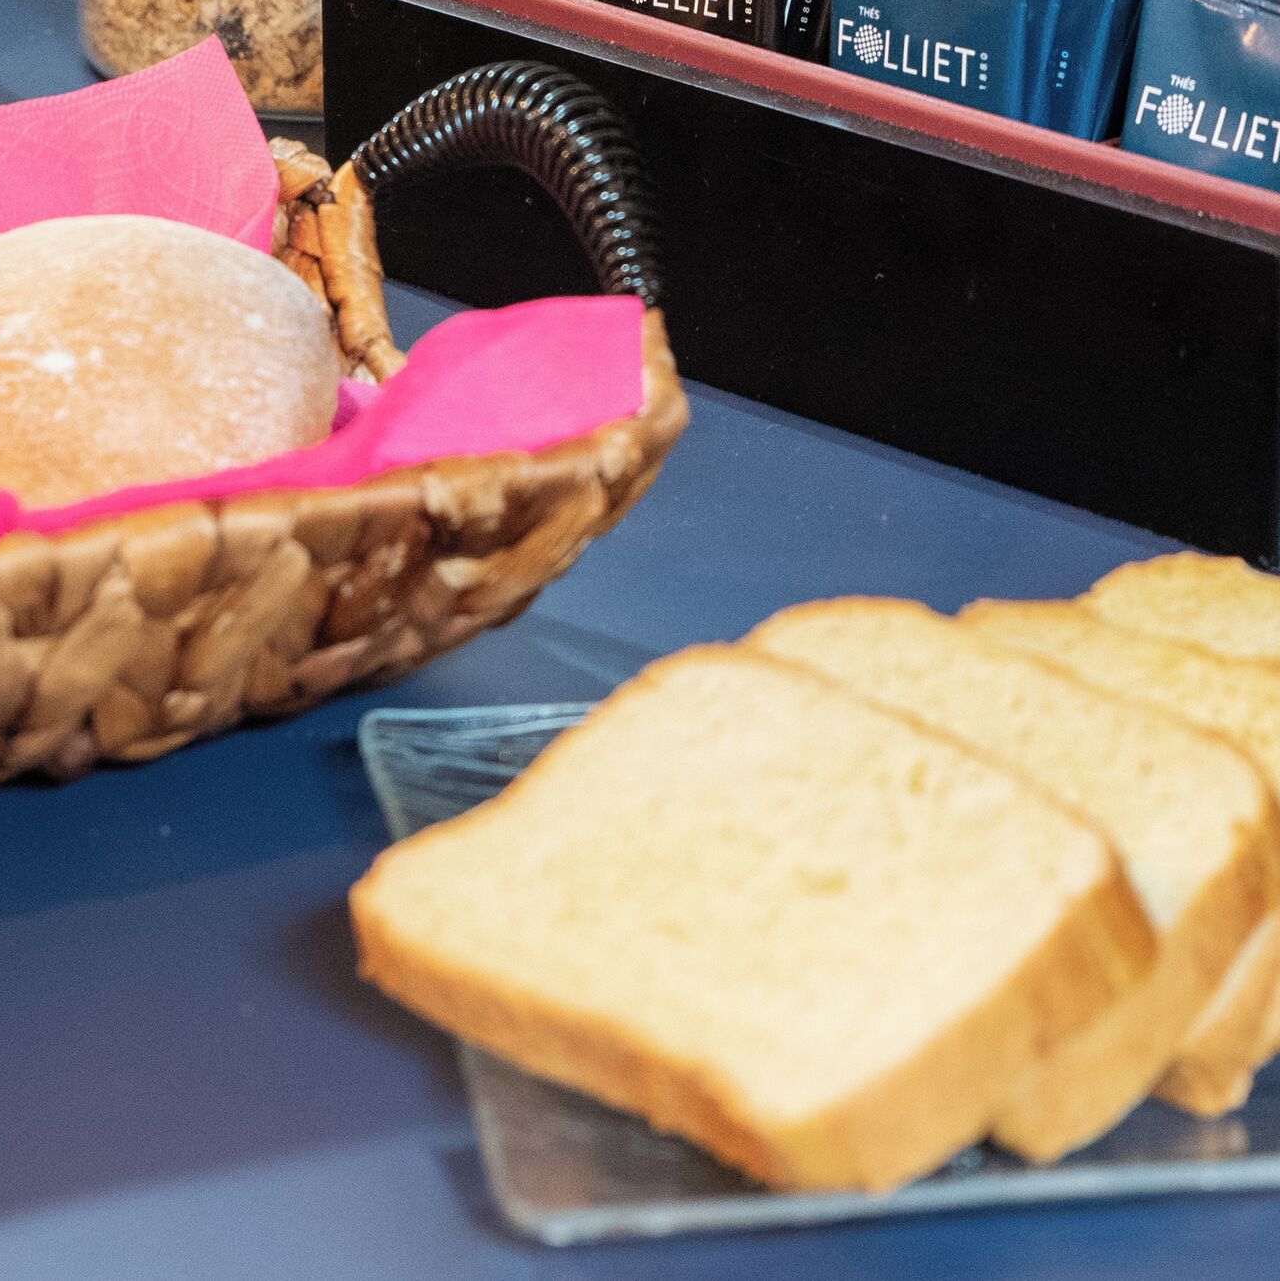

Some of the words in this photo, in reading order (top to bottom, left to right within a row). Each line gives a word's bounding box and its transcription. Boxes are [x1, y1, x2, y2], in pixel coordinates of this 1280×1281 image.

[858, 5, 880, 20] THÉS
[837, 18, 976, 87] FOLLIET
[978, 52, 988, 90] 1880
[1055, 50, 1069, 88] 1880
[1170, 74, 1196, 92] THÉS
